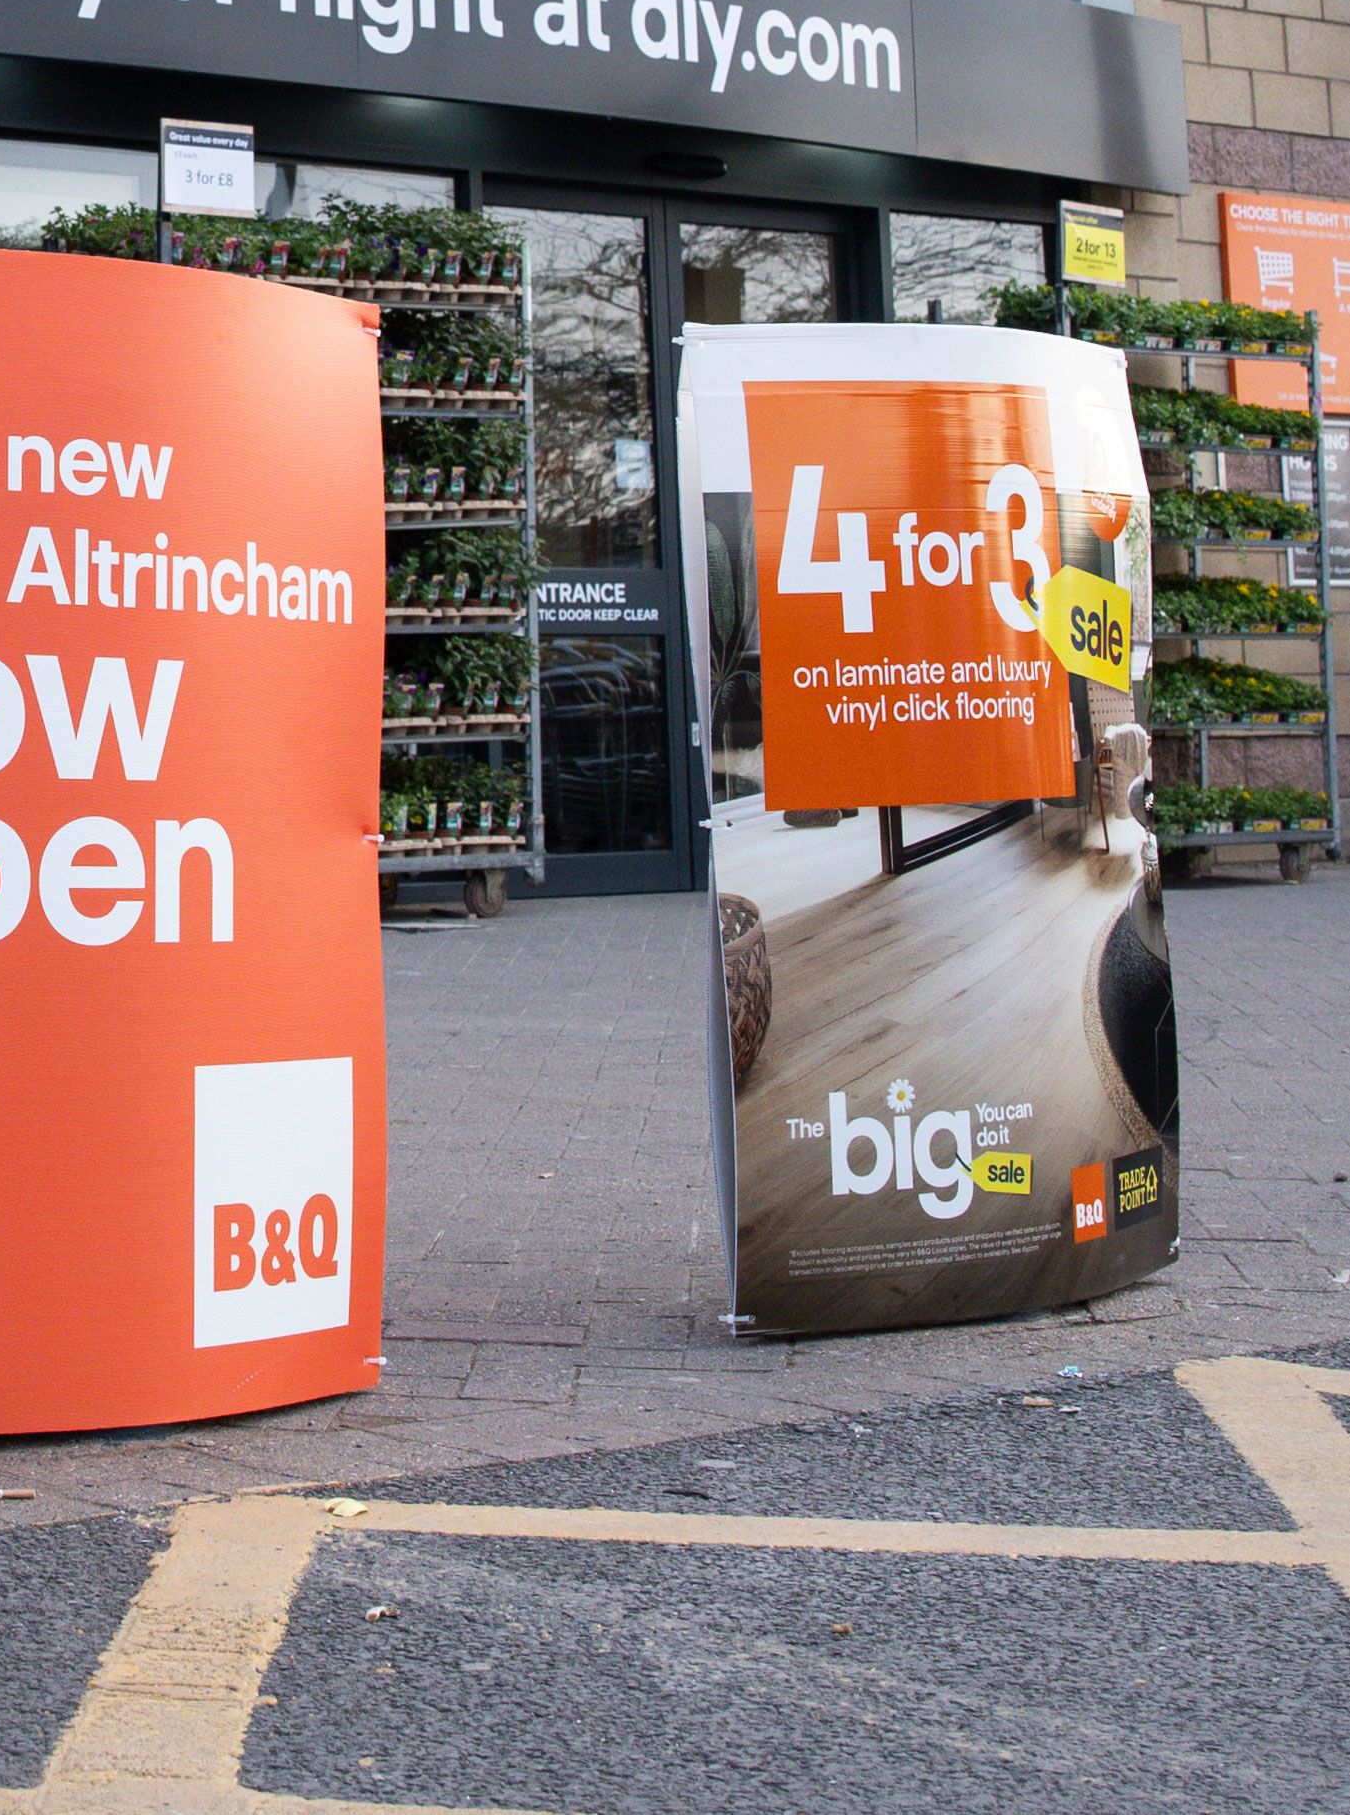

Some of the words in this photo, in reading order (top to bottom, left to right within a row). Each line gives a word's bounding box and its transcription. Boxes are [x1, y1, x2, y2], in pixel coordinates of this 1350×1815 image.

[169, 131, 190, 142] Great
[192, 134, 212, 145] value
[213, 136, 234, 148] every
[234, 138, 249, 150] day
[186, 169, 193, 183] 3
[197, 170, 215, 185] for
[219, 173, 234, 187] £8
[1229, 202, 1278, 223] CHOOSE
[1282, 208, 1302, 225] THE
[1306, 210, 1340, 229] RIGHT
[1076, 237, 1083, 253] 2
[1085, 239, 1100, 255] for
[8, 436, 173, 500] new
[778, 465, 886, 632] 4
[893, 512, 985, 587] for
[986, 463, 1051, 633] 3
[7, 527, 352, 624] Altrincham
[536, 583, 626, 603] NTRANCE
[558, 608, 591, 621] DOOR
[594, 608, 622, 621] KEEP
[623, 608, 659, 621] CLEAR
[1070, 599, 1124, 666] sale
[794, 667, 828, 688] on
[836, 658, 945, 686] laminate
[951, 654, 993, 684] and
[997, 654, 1052, 689] luxury
[826, 695, 886, 730] vinyl
[893, 693, 950, 722] click
[974, 1103, 1006, 1124] You
[1007, 1101, 1033, 1121] can
[976, 1125, 998, 1147] do
[999, 1125, 1010, 1145] it
[786, 1117, 825, 1141] The
[828, 1090, 975, 1220] big
[987, 1160, 1025, 1184] sale
[1118, 1166, 1146, 1193] TRADE
[1076, 1198, 1104, 1228] B&Q
[1118, 1187, 1146, 1215] POINT
[213, 1192, 339, 1291] B&Q
